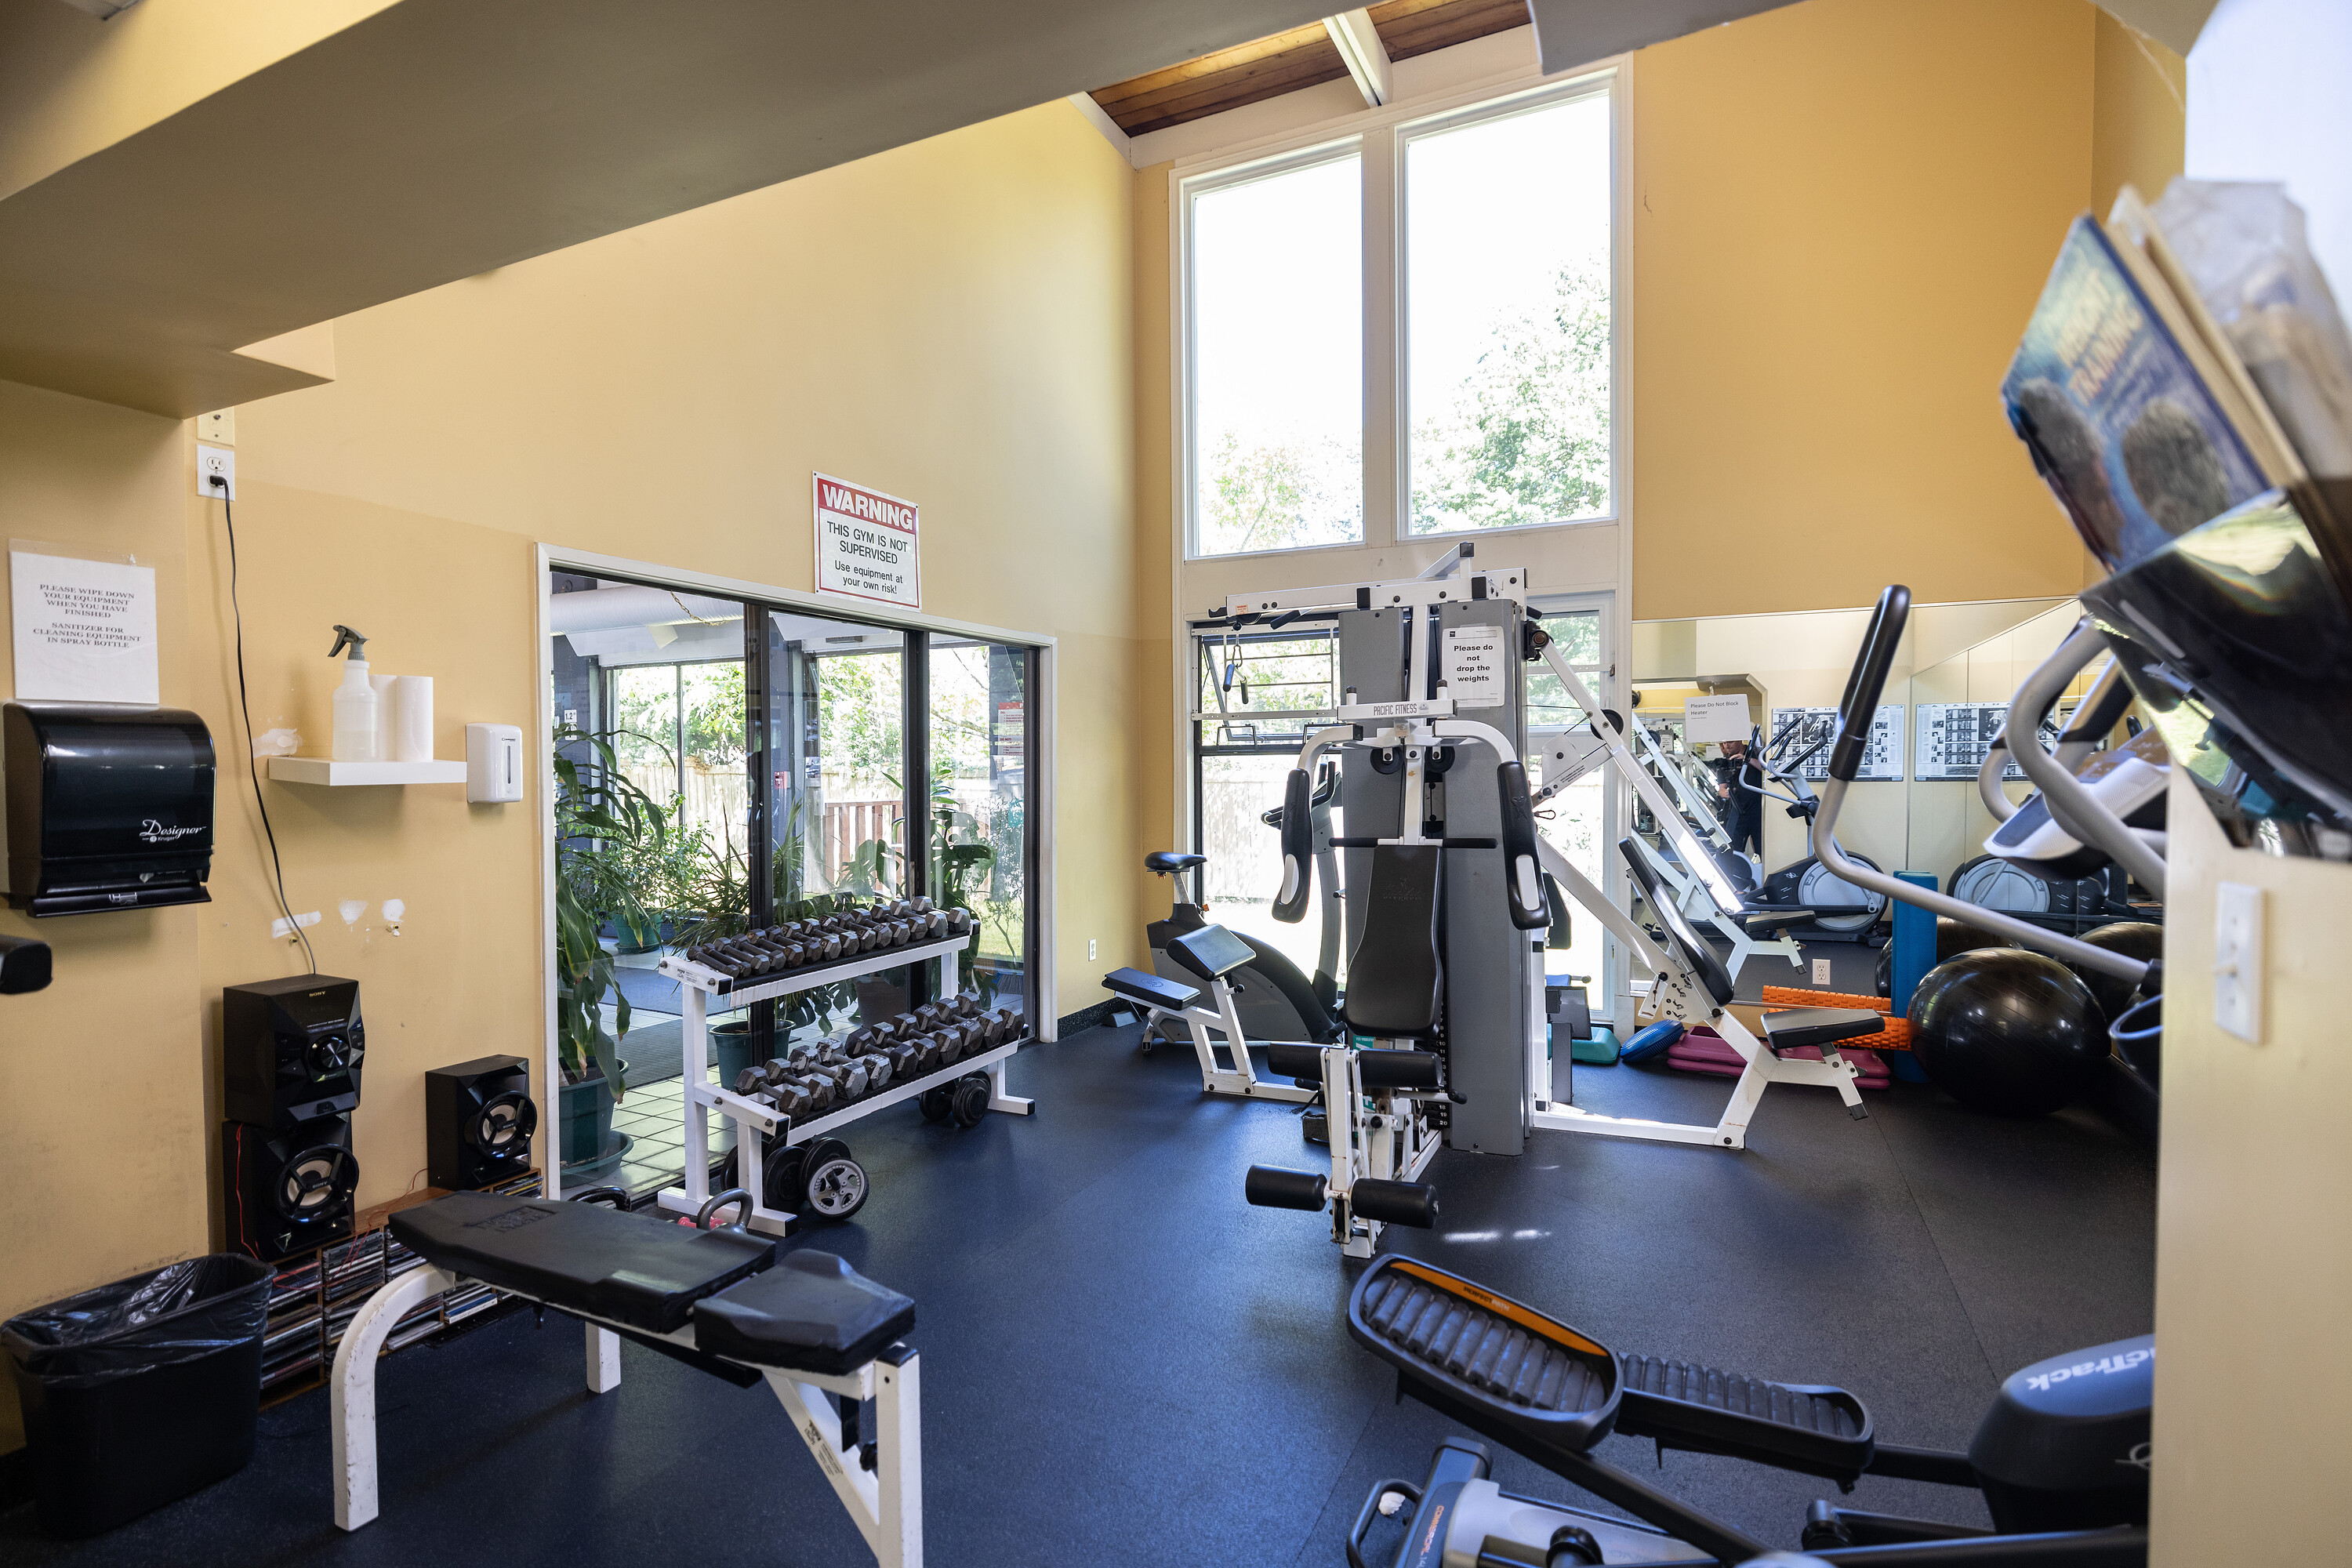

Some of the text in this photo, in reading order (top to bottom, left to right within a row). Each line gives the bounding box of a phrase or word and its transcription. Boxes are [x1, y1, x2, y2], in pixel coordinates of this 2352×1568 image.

[822, 484, 913, 531] WARNING
[827, 521, 908, 552] THIS GYM IS NOT
[840, 540, 898, 564] SUPERVISED
[835, 560, 903, 584] Use equipment at
[39, 584, 77, 593] PLEASE
[106, 590, 135, 599] DOWN
[843, 576, 898, 594] your own risk!
[74, 595, 130, 605] EQUIPMENT
[65, 609, 111, 618] FINISHED
[33, 628, 142, 641] CLEANING EQUIPMENT
[52, 622, 103, 632] SANITIZER
[1374, 703, 1417, 716] PACIFIC FITNESS
[139, 819, 202, 839] Designer
